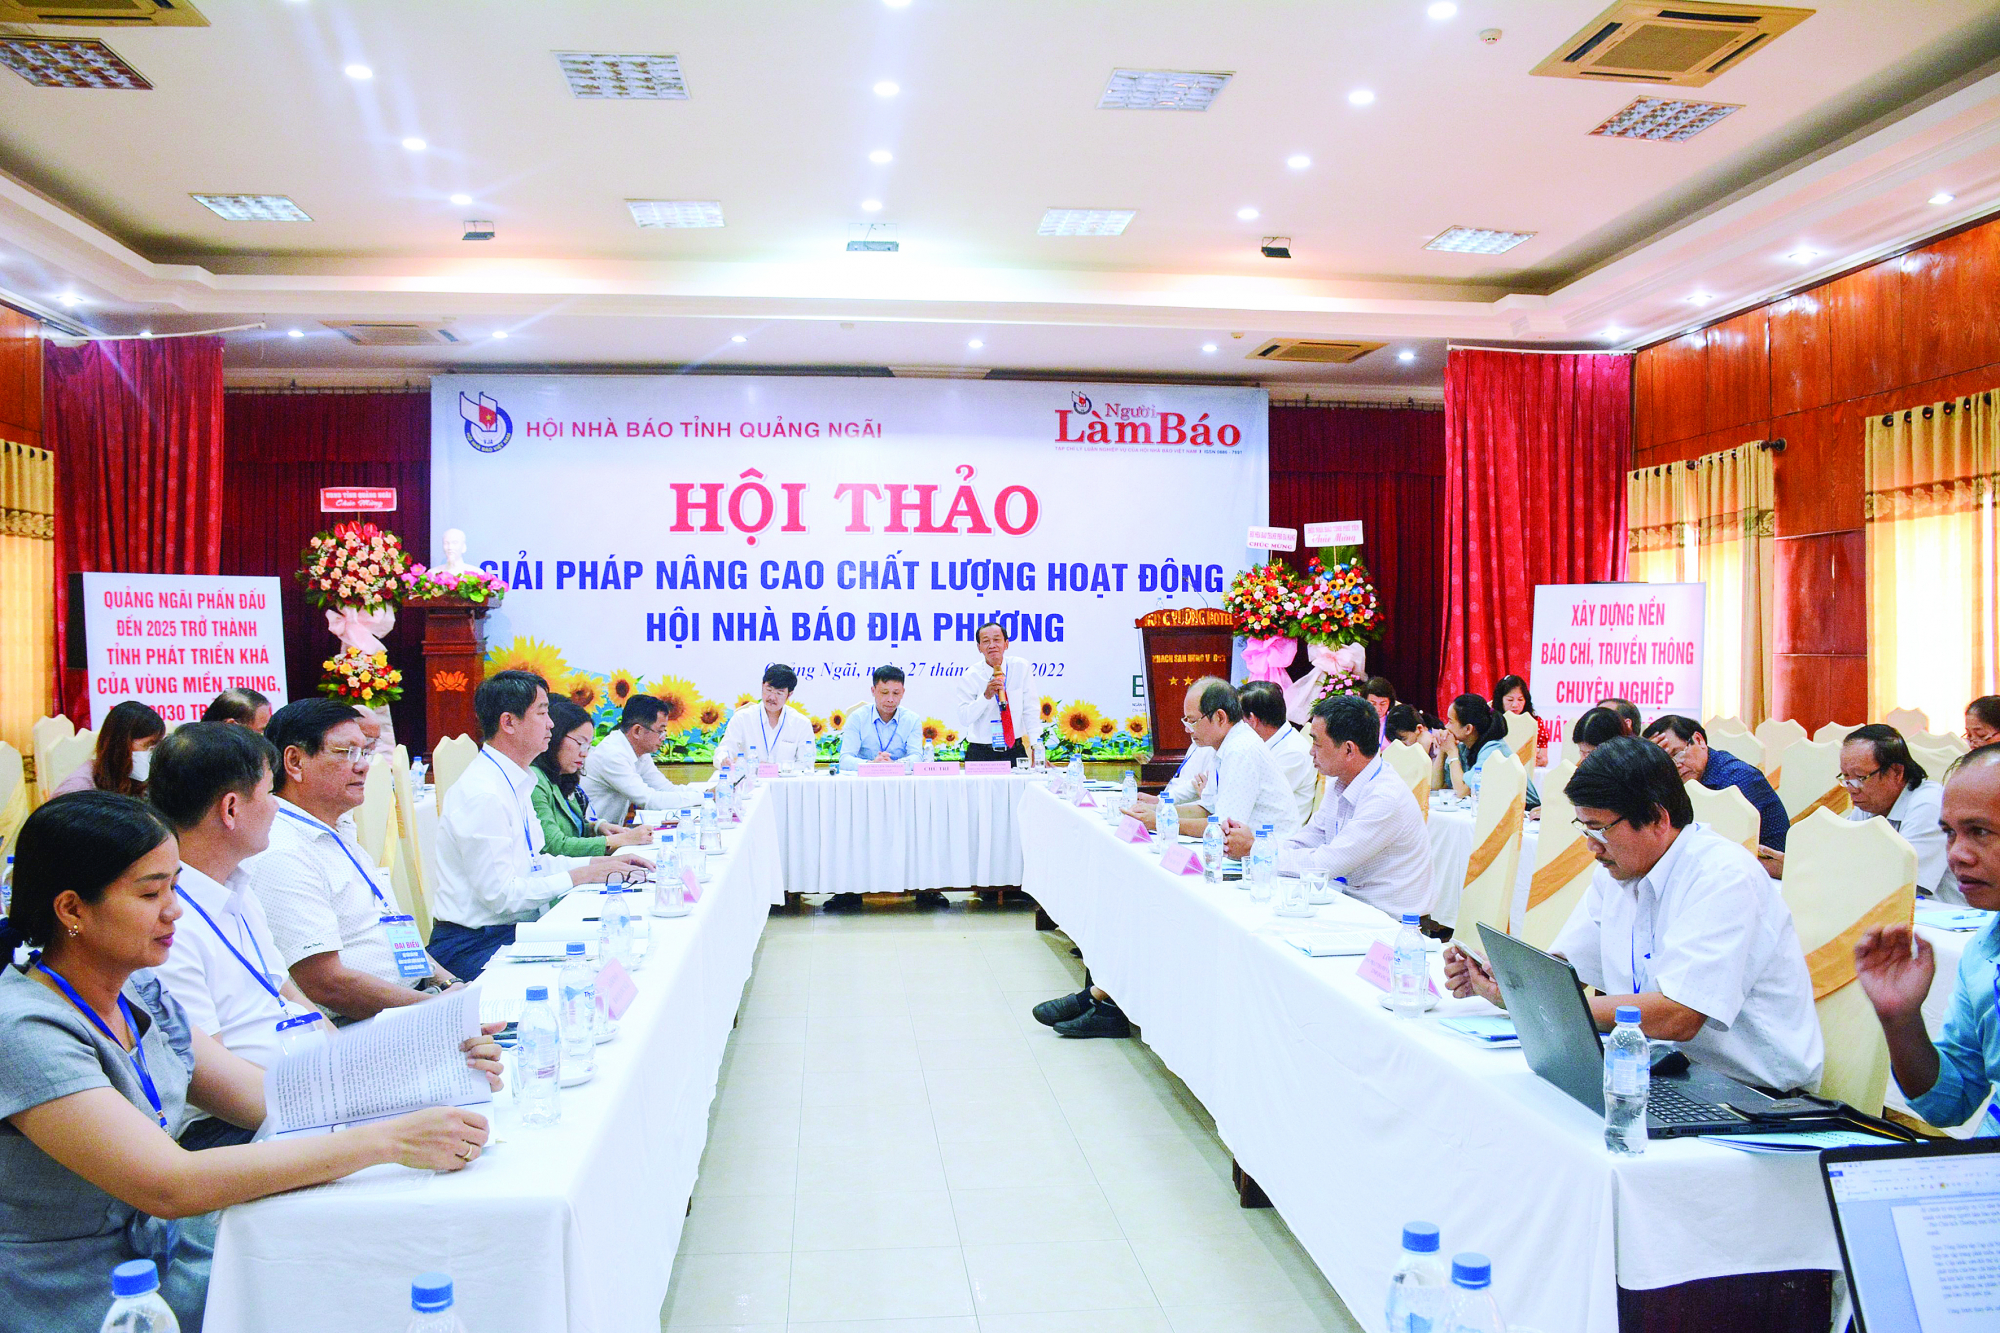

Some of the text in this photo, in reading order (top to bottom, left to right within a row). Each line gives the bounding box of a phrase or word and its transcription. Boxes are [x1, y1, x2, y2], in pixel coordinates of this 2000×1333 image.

[1105, 403, 1157, 420] Người
[526, 414, 882, 441] HỘI NHÀ BÁO TỈNH QUẢNG NGÃI
[669, 463, 1040, 547] HỘI THẢO
[556, 554, 643, 590] PHÁP
[656, 554, 747, 590] NÂNG
[760, 559, 824, 590] CAO
[836, 549, 920, 590] CHẤT
[931, 558, 1036, 598] LƯỢNG
[1048, 562, 1128, 598] HOẠT
[1138, 558, 1224, 599] ĐỘNG
[104, 586, 266, 610] QUẢNG NGÃI PHẤN ĐẤU
[116, 614, 258, 637] ĐẾN 2025 TRỞ THÀNH
[1206, 611, 1234, 626] HOTEL
[1571, 595, 1665, 631] XÂY DỰNG NỀN
[647, 606, 699, 648] HỘI
[712, 604, 779, 641] NHÀ
[791, 604, 856, 641] BÁO
[867, 612, 922, 648] ĐỊA
[106, 641, 269, 665] TỈNH PHÁT TRIỂN KHÁ
[1541, 634, 1694, 667] BÁO CHÍ, TRUYỀN THÔNG
[97, 671, 130, 694] CỦA
[135, 673, 177, 694] VÙNG
[183, 671, 223, 693] MIỀN
[820, 661, 861, 681] Ngãi,
[907, 662, 926, 677] 27
[930, 661, 970, 677] thán
[1556, 676, 1675, 710] CHUYÊN NGHIỆP
